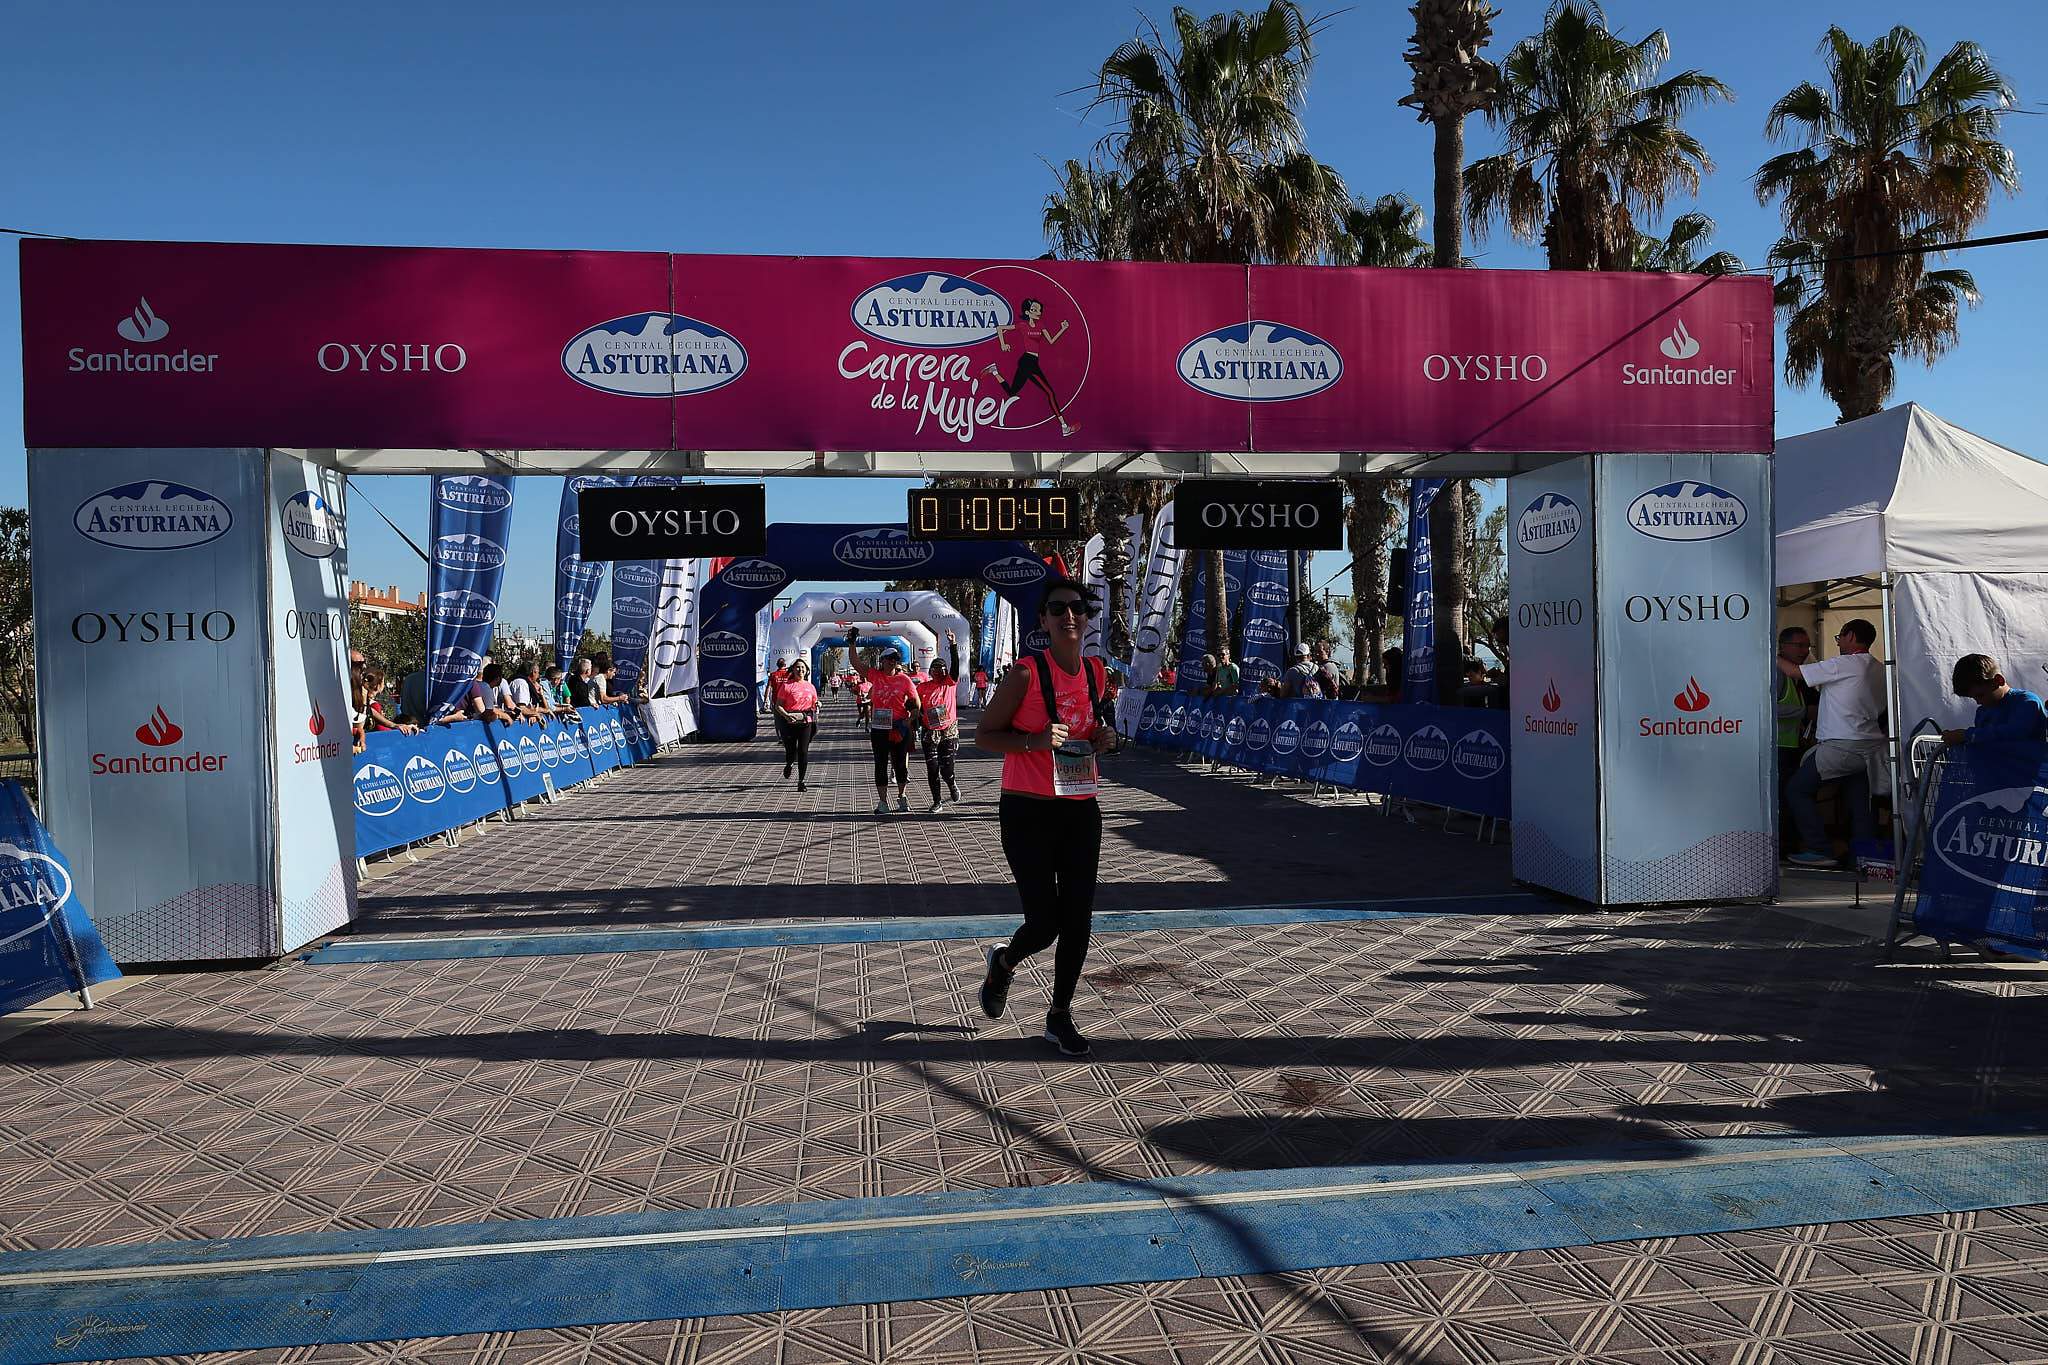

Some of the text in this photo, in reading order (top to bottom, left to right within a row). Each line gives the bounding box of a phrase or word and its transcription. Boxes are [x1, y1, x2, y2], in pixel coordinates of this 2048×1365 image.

[863, 298, 1000, 329] ASTURIANA
[888, 297, 996, 307] CENTRAL LECHERA
[604, 340, 663, 350] CENTRAL
[1215, 347, 1326, 357] CENTRAL LECHERA
[68, 347, 219, 373] Santander
[316, 343, 468, 373] OYSHO
[576, 342, 734, 375] ASTURIANA
[837, 340, 971, 382] Carrera
[1188, 349, 1331, 382] ASTURIANA
[1422, 353, 1548, 382] OYSHO
[1622, 362, 1737, 386] Santander
[871, 378, 1021, 443] de la Mujer
[110, 504, 216, 513] CENTRAL LECHERA
[920, 497, 1067, 531] 01:00:49
[1201, 502, 1320, 529] OYSHO
[1636, 503, 1738, 527] ASTURIANA
[1652, 501, 1735, 509] CENTRAL LECHERA
[86, 506, 222, 533] ASTURIANA
[609, 509, 741, 537] OYSHO
[1520, 517, 1577, 543] ASTURIANA
[840, 541, 928, 560] ASTURIANA
[726, 570, 783, 583] ASTURIANA
[830, 597, 910, 615] OYSHO
[1517, 597, 1583, 629] OYSHO
[1624, 593, 1750, 623] OYSHO
[71, 610, 236, 644] OYSHO
[285, 608, 343, 642] OYSHO
[1524, 714, 1578, 737] Santander
[1639, 716, 1743, 737] Santander
[92, 751, 228, 775] Santander
[294, 739, 341, 764] Santander
[1406, 740, 1445, 761] ASTURIANA
[1455, 741, 1498, 769] ASTURIANA
[356, 784, 402, 807] ASTURIANA
[408, 775, 444, 794] ASTURIANA
[1978, 816, 2040, 833] CENTRAL
